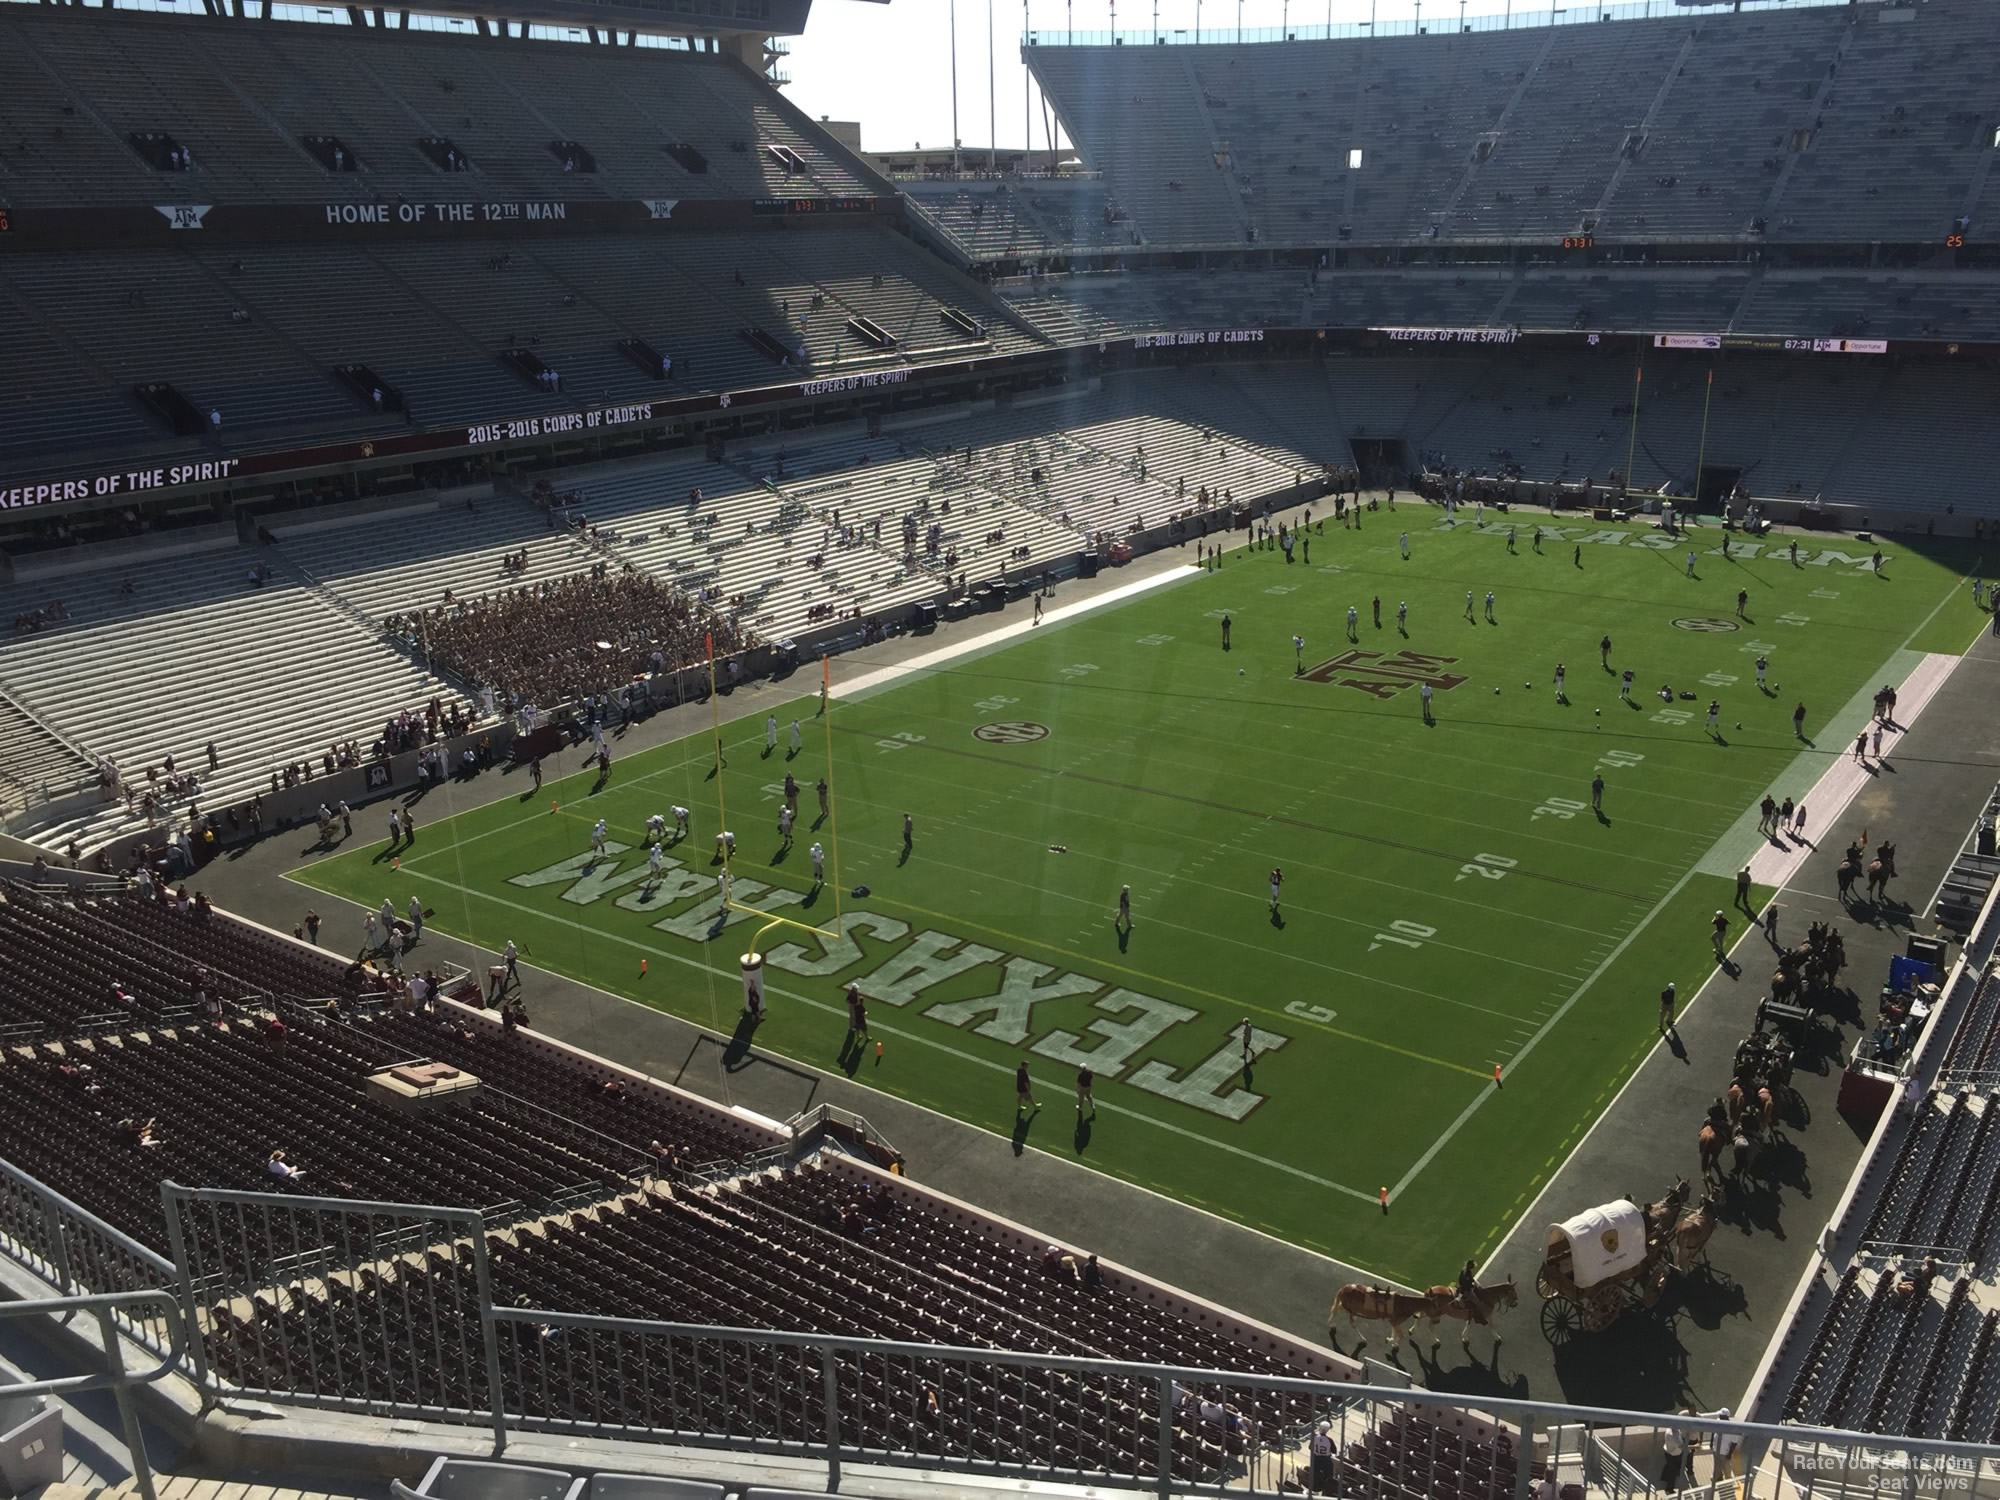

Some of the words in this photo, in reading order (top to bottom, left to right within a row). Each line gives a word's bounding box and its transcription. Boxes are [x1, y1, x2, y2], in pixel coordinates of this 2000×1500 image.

[325, 204, 391, 224] HOME
[398, 203, 426, 223] OF
[434, 203, 475, 222] THE
[482, 203, 520, 220] 12TH
[526, 202, 566, 220] MAN
[1947, 235, 1963, 247] 25
[1178, 332, 1205, 344] CORPS
[1208, 331, 1221, 343] OF
[1224, 330, 1264, 342] CADETS
[1386, 330, 1437, 341] "KEEPERS
[1439, 331, 1453, 341] OF
[1456, 331, 1477, 342] THE
[1479, 331, 1523, 343] SPIRIT"
[1784, 339, 1811, 350] 67:31
[1851, 342, 1882, 350] Opportune
[800, 379, 846, 396] "KEEPERS
[847, 377, 860, 390] OF
[862, 374, 879, 388] THE
[880, 370, 913, 385] SPIRIT"
[468, 420, 539, 444] 2015-2016
[543, 414, 584, 433] CORPS
[586, 411, 602, 427] OF
[605, 405, 652, 425] CADETS
[0, 479, 89, 509] KEEPERS
[95, 475, 121, 495] OF
[127, 469, 164, 490] THE
[169, 459, 239, 484] SPIRIT"
[1430, 516, 1692, 551] TEXAS
[1702, 540, 1896, 572] A&M
[1060, 663, 1101, 676] 40
[1698, 672, 1739, 687] 40
[973, 695, 1021, 711] 30
[1649, 708, 1695, 726] 50
[875, 731, 927, 750] 20
[975, 722, 1047, 744] SEC
[1598, 749, 1646, 768] 40
[1533, 797, 1588, 820] 30
[1460, 853, 1519, 880] 20
[502, 838, 811, 943] A&M
[1374, 919, 1438, 950] 10
[763, 909, 1294, 1123] TEXAS
[1283, 1000, 1338, 1024] G
[1315, 1443, 1328, 1455] 12
